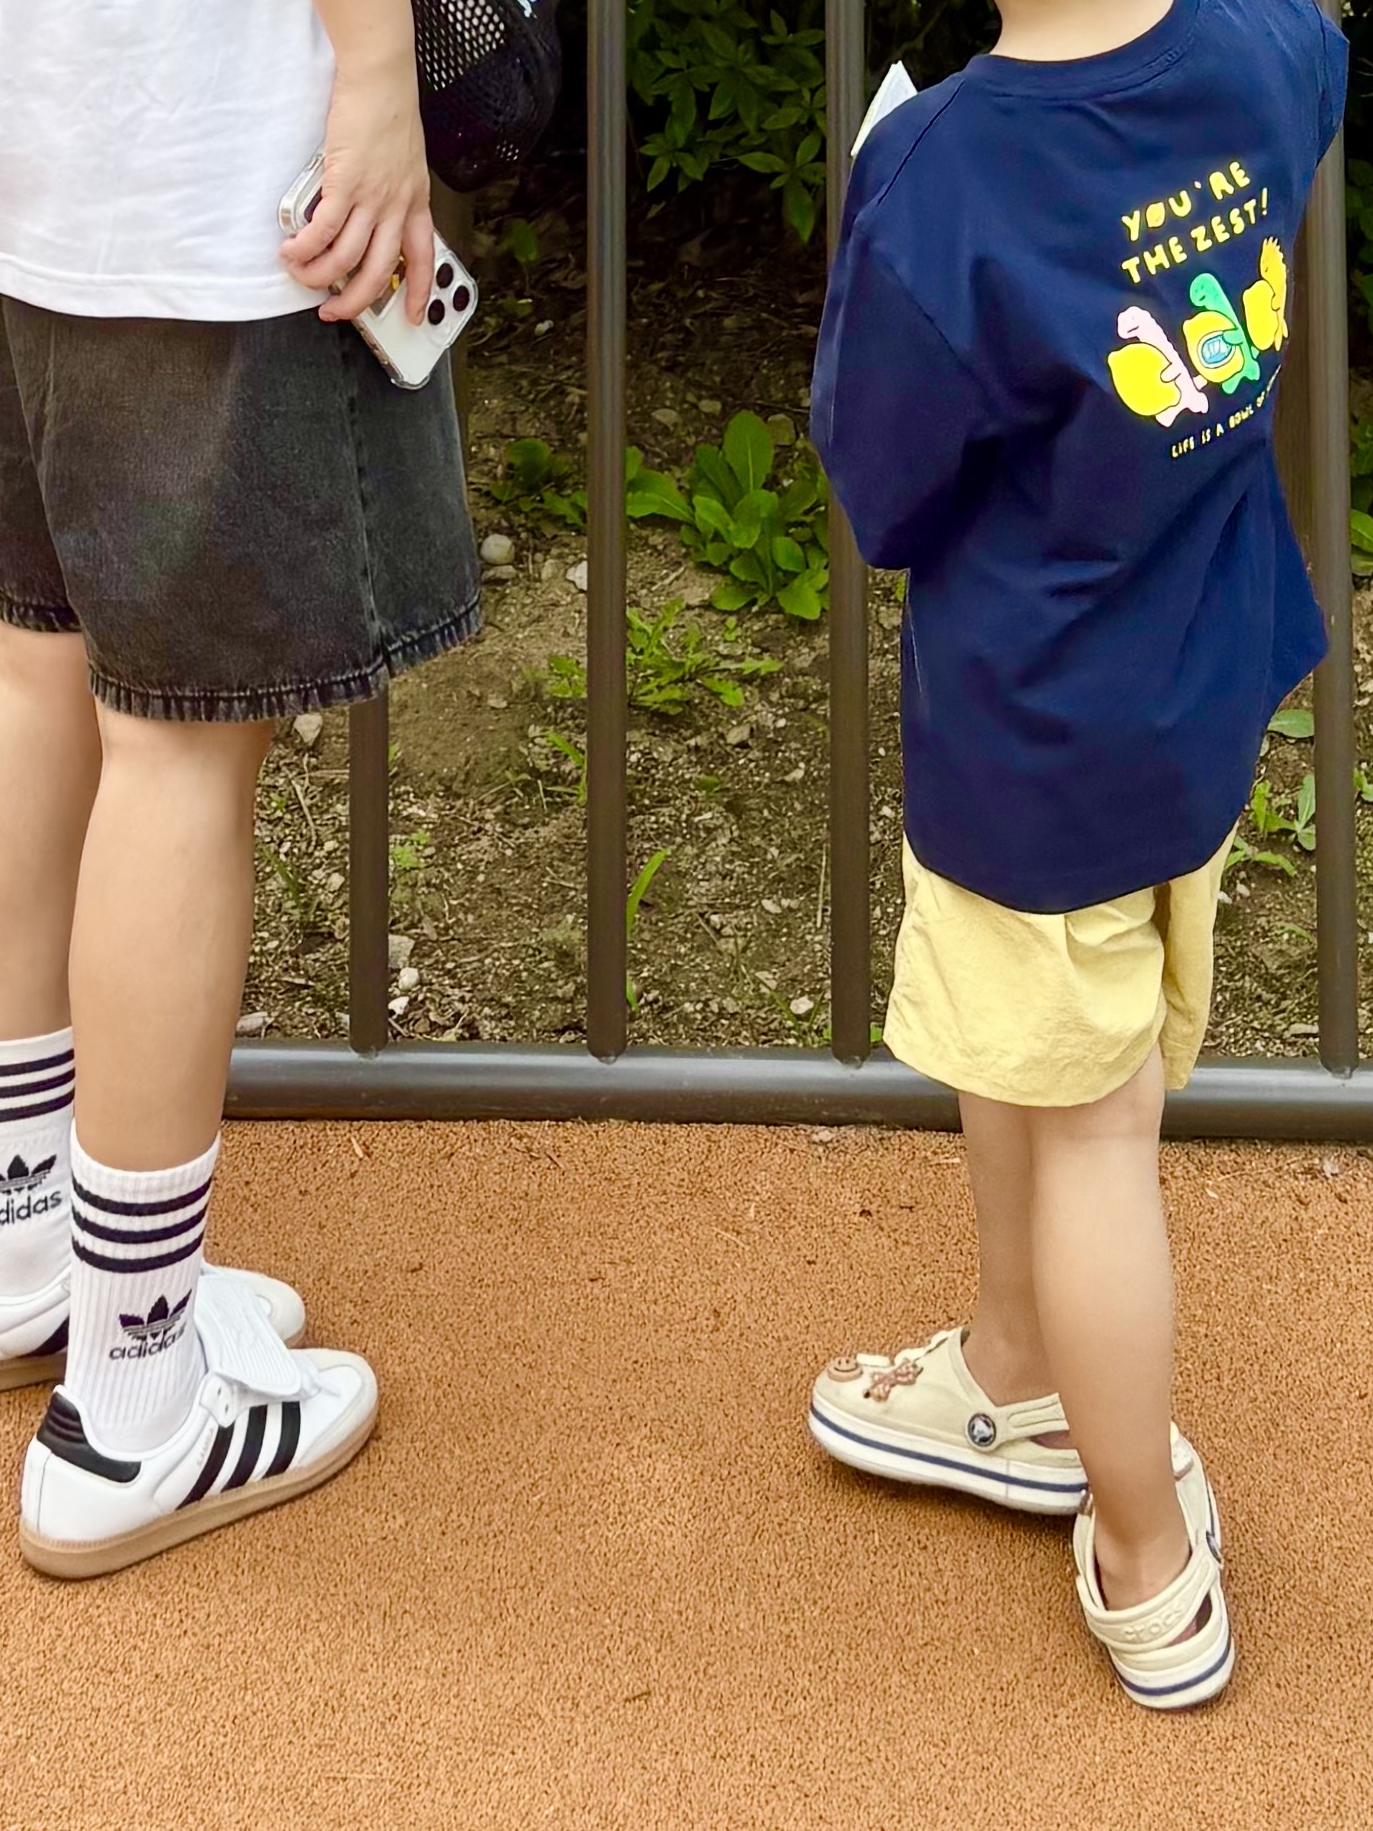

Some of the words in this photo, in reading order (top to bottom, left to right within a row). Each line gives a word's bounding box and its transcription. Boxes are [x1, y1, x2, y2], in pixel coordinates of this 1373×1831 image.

[1121, 236, 1188, 284] THE
[1190, 187, 1268, 252] ZEST!
[1171, 435, 1195, 458] LIFE
[1201, 428, 1211, 445] IS
[1215, 422, 1225, 437] A
[1228, 403, 1254, 429] BOWL
